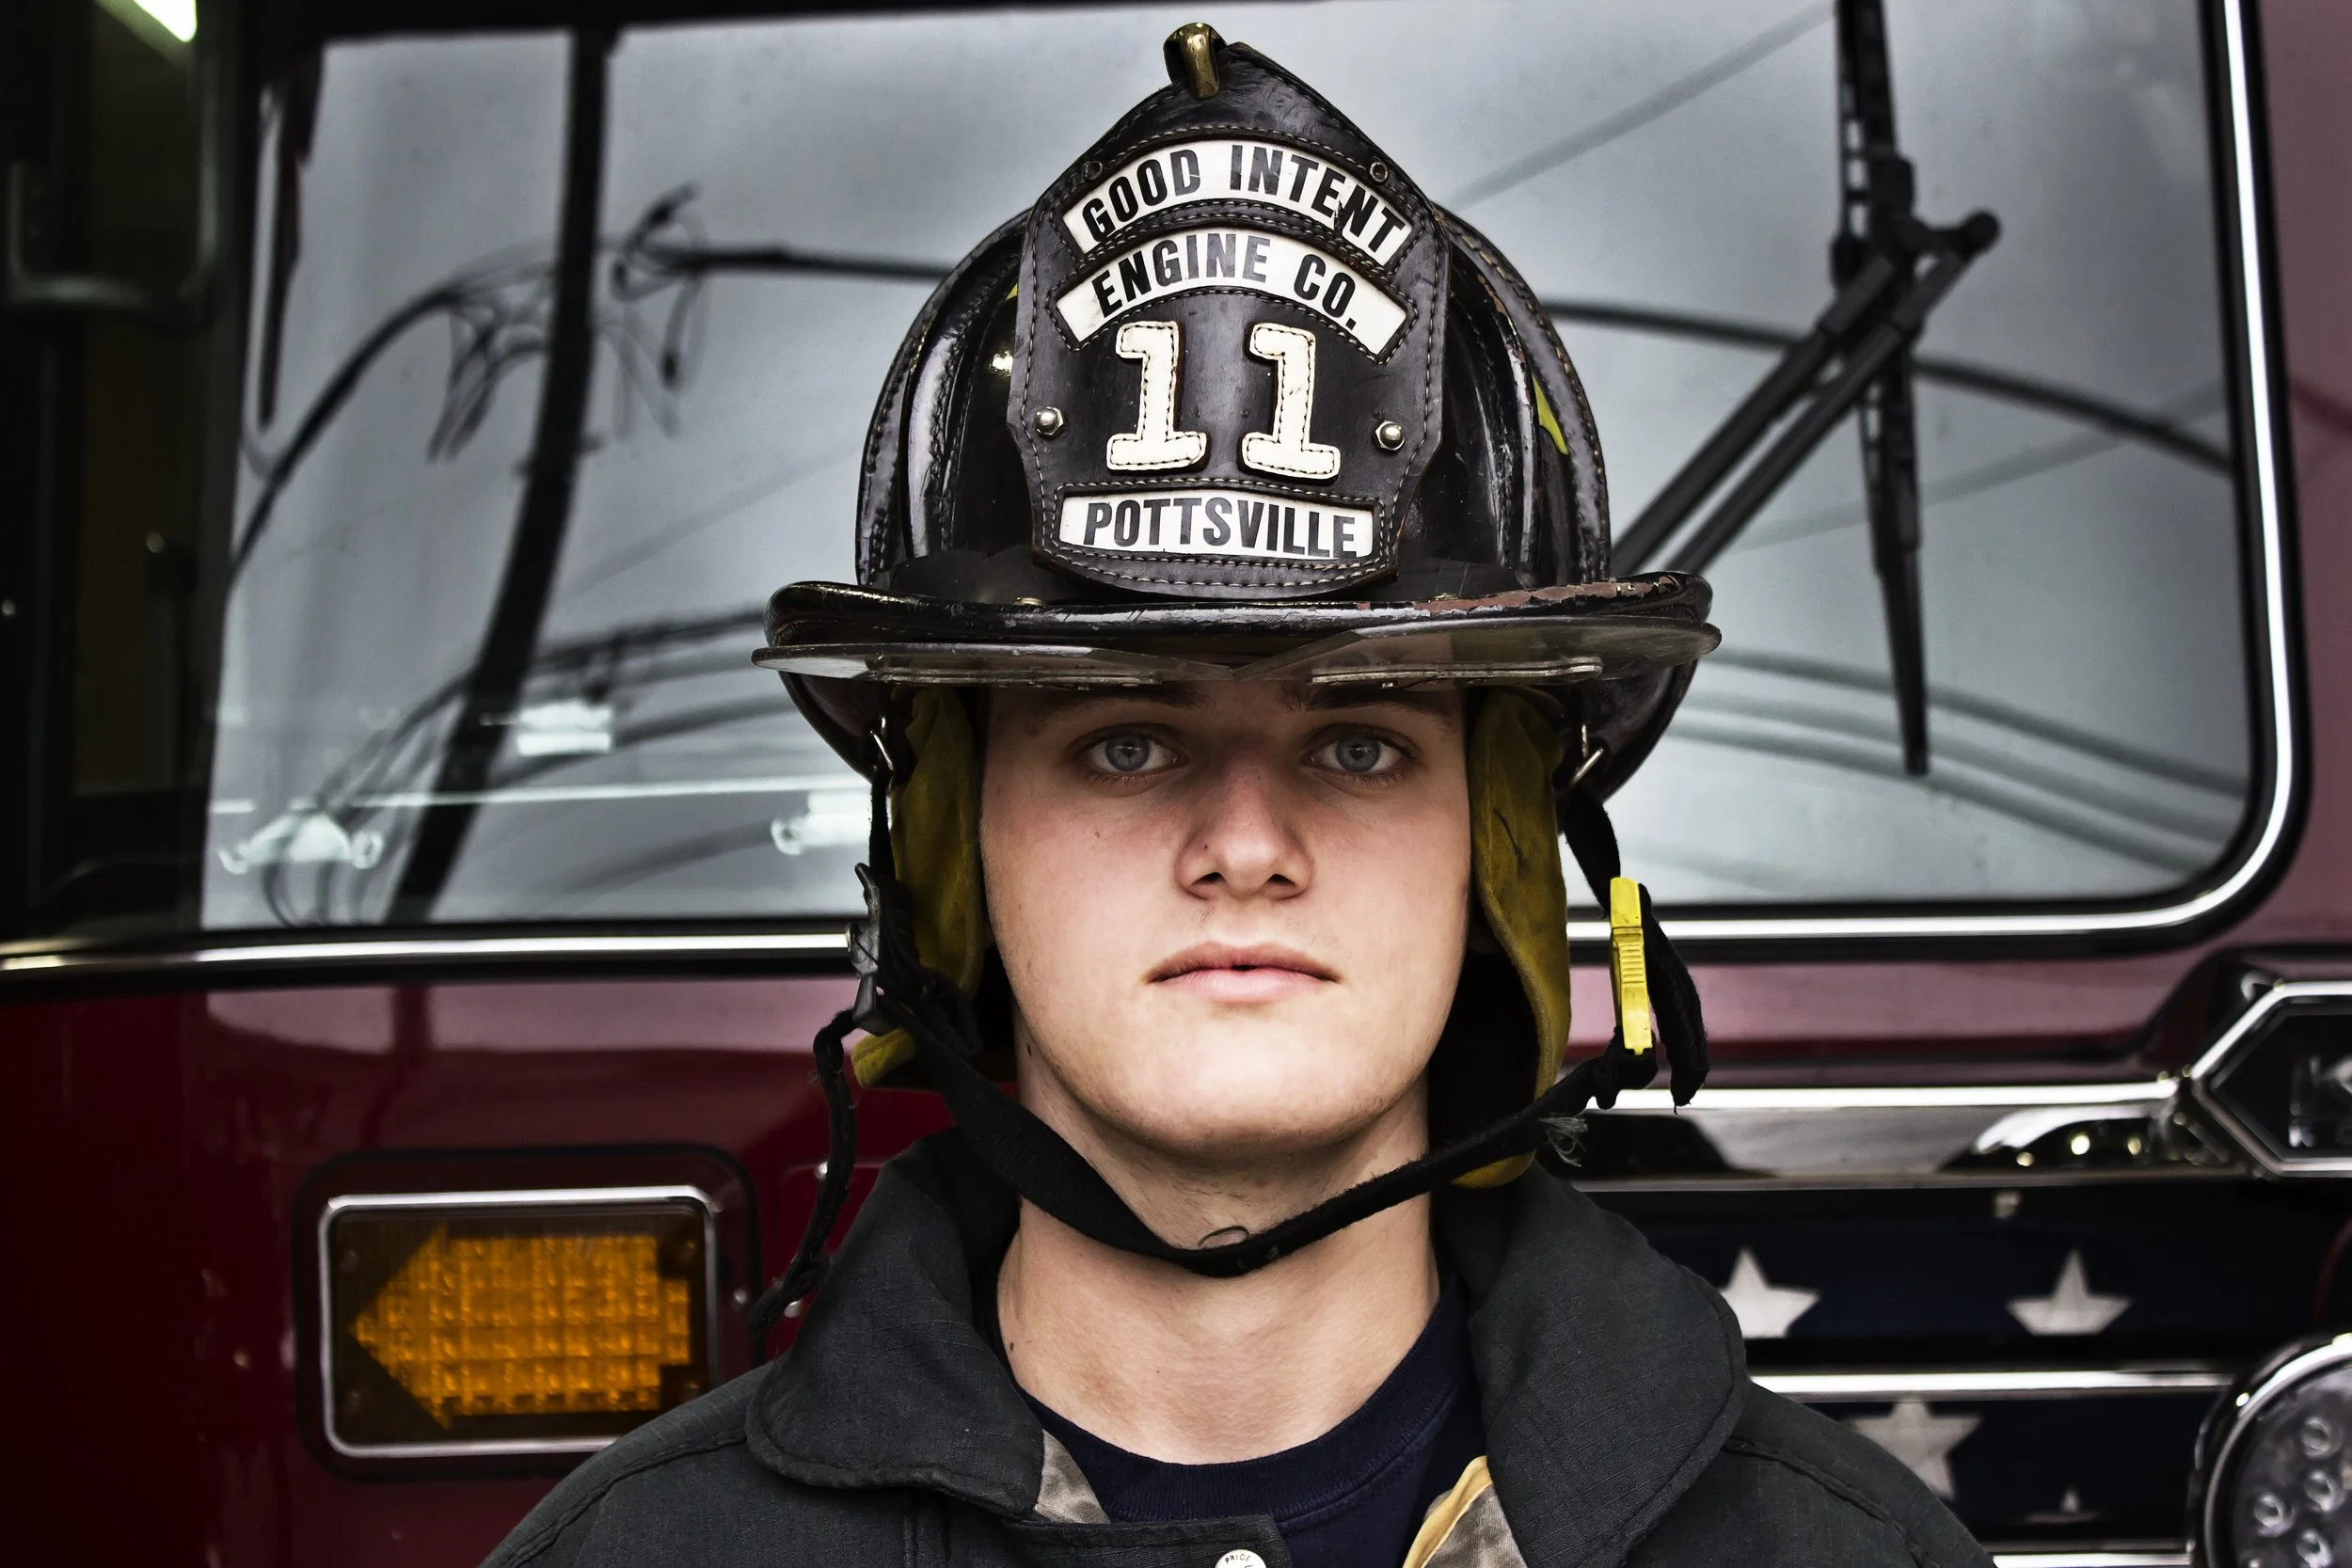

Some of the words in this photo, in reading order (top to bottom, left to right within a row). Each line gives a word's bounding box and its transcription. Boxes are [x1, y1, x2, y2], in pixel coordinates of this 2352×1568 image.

[1081, 149, 1201, 243] GOOD
[1229, 144, 1406, 254] INTENT
[1090, 232, 1272, 318] ENGINE
[1294, 253, 1357, 331] CO.
[1106, 320, 1342, 480] 11
[1083, 496, 1358, 559] POTTSVILLE
[1225, 1553, 1251, 1564] PRIDE
